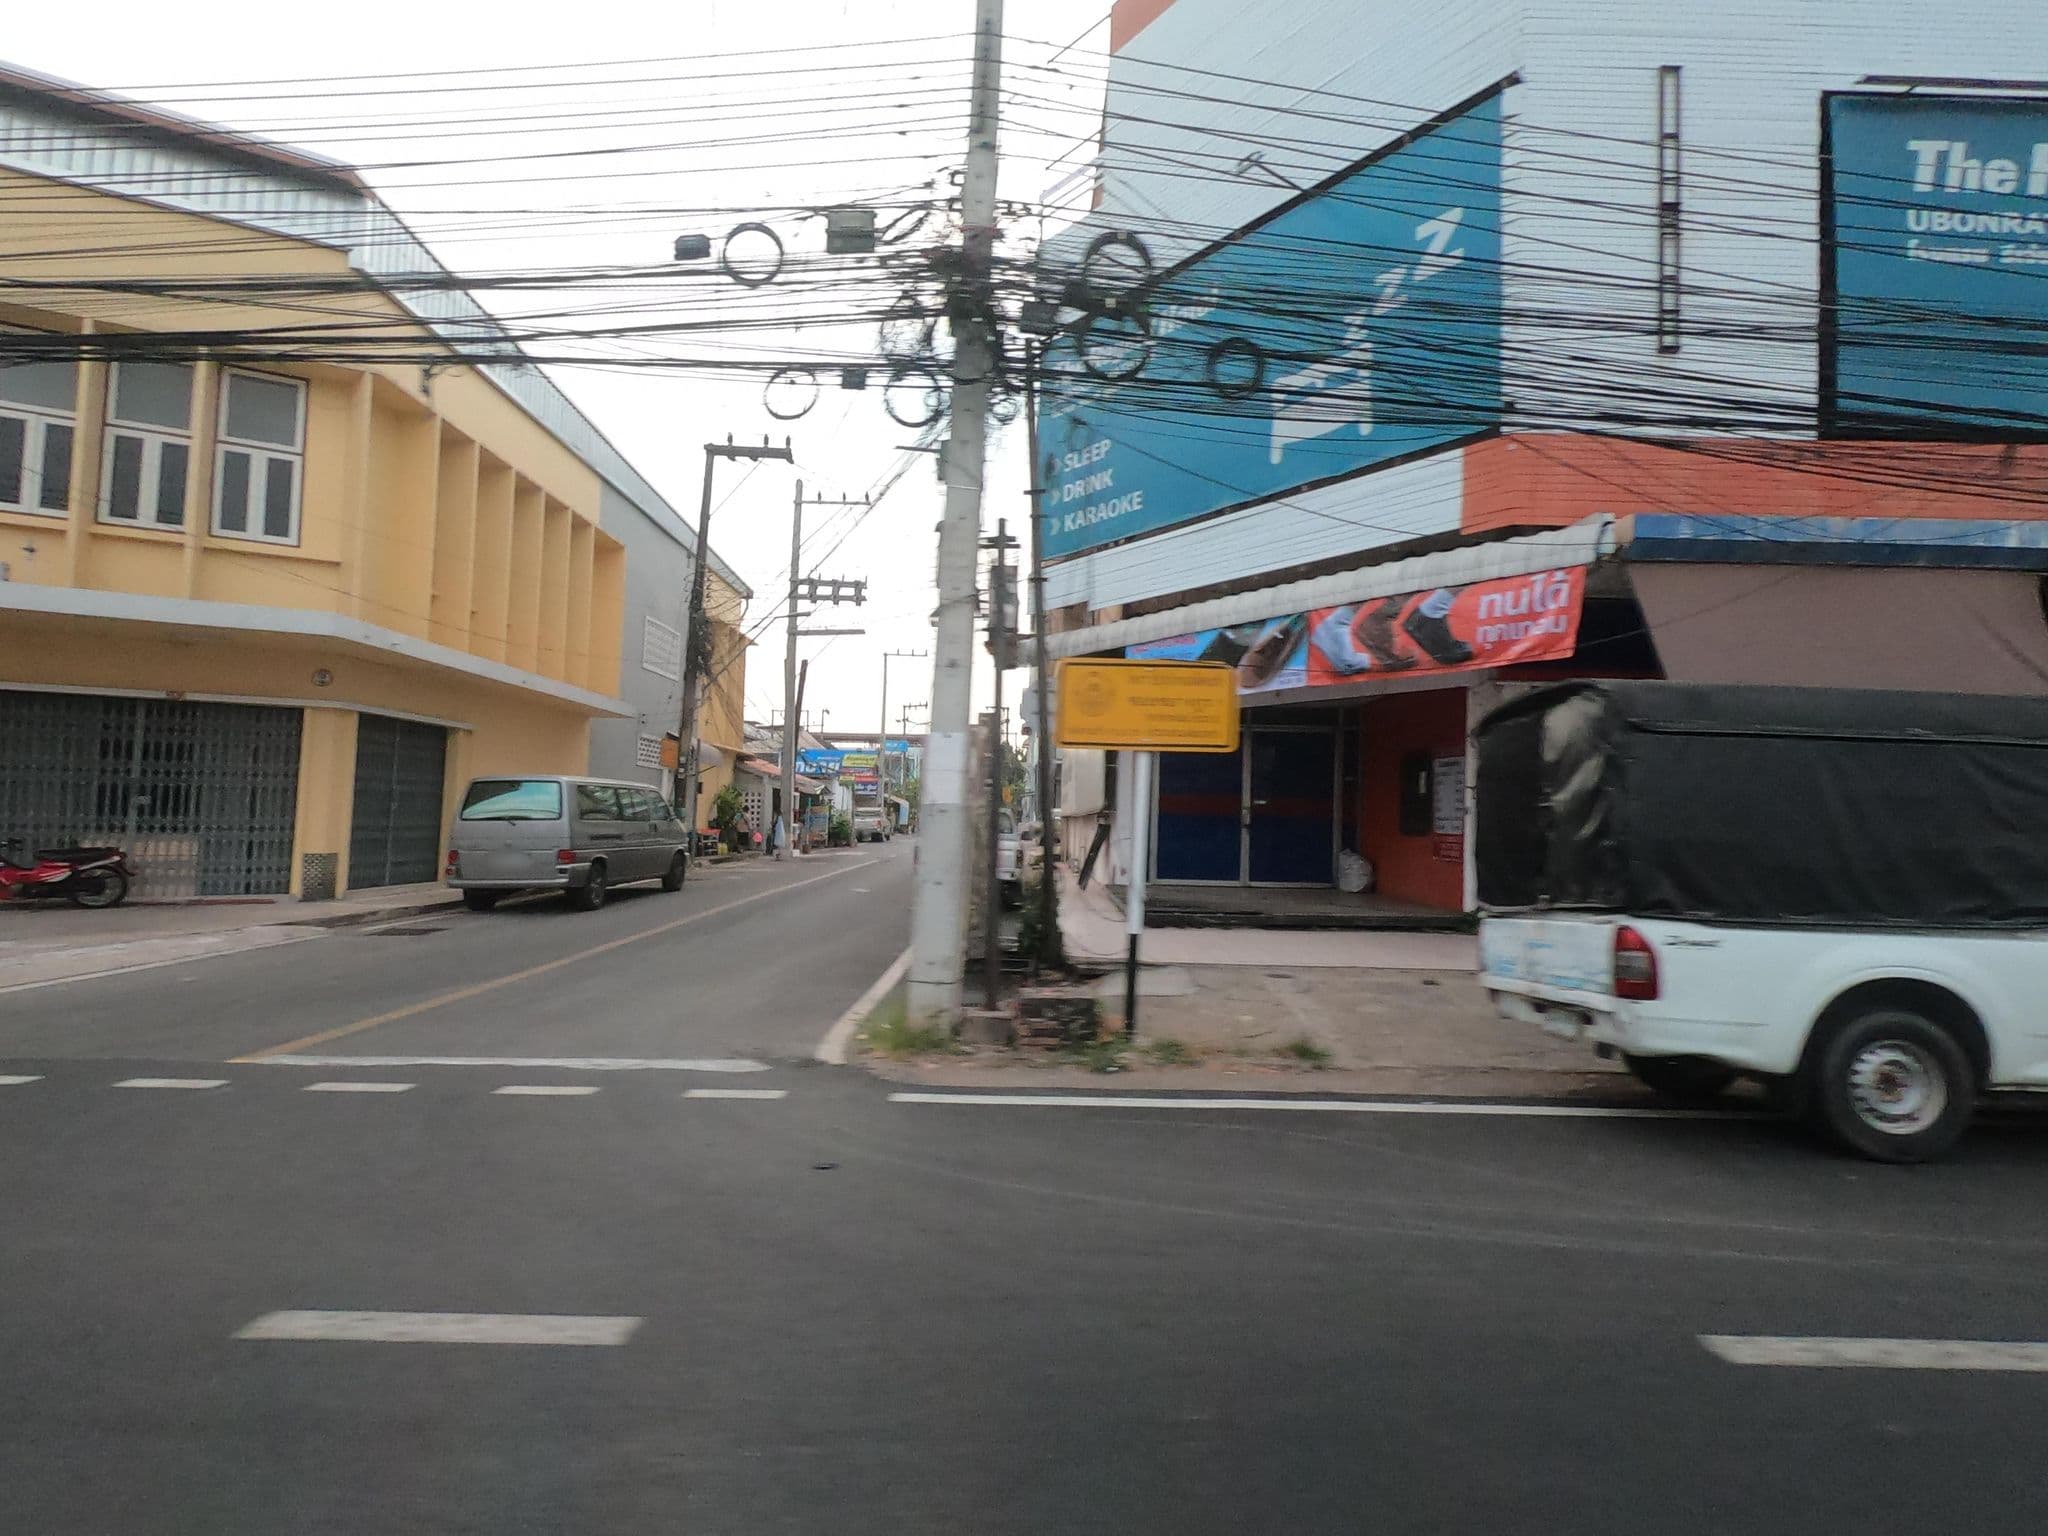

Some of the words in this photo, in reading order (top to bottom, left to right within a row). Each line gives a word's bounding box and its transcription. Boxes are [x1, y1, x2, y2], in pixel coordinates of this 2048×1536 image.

[1906, 140, 2018, 194] The
[1906, 207, 2048, 234] UBONRA
[1063, 438, 1112, 472] SLEEP
[1063, 468, 1113, 503] DRINK
[1063, 489, 1144, 532] KARAOKE
